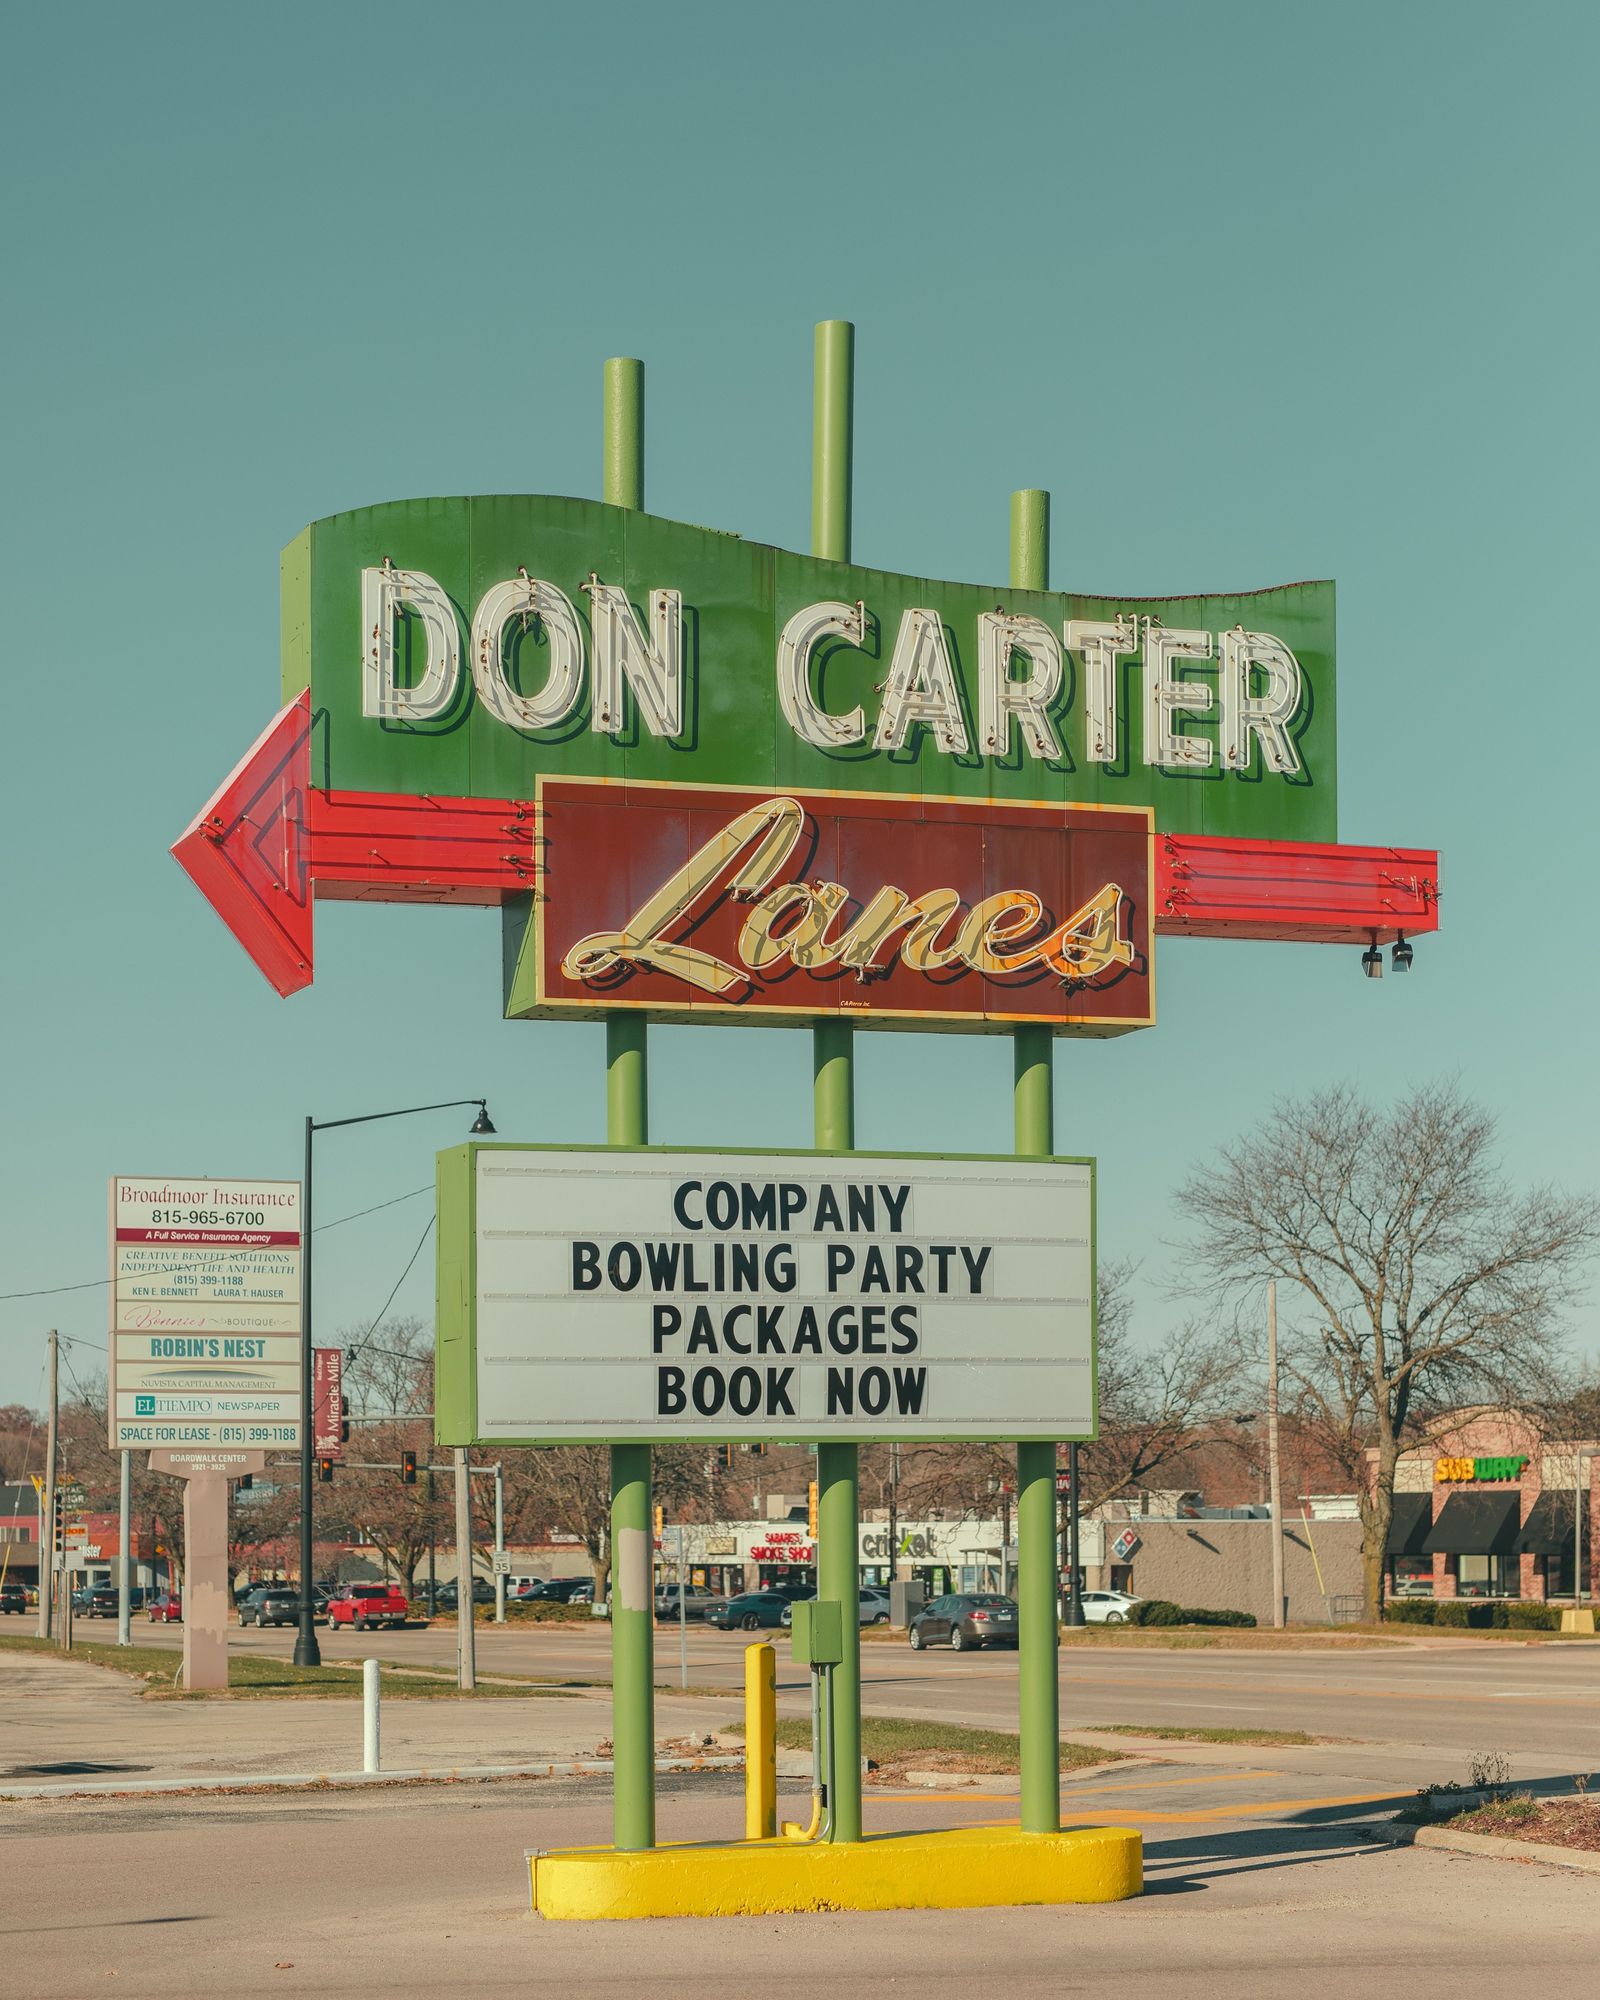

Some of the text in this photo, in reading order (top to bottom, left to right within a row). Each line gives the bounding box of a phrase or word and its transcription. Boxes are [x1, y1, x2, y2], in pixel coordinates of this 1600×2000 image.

[361, 567, 1301, 773] DON CARTER
[560, 795, 1135, 993] Lanes
[120, 1184, 295, 1206] Broadmoor Insurance
[673, 1180, 911, 1233] COMPANY
[152, 1210, 264, 1225] 815-965-6700
[145, 1231, 271, 1243] A Full Service Insurance Agency
[126, 1251, 290, 1262] CREATIVE BENEFIT SOLUTIONS
[121, 1263, 295, 1275] INDEPENDENT LIFE AND HEALTH
[572, 1241, 992, 1294] BOWLING PARTY
[173, 1275, 244, 1286] (815) 399-1188
[132, 1287, 150, 1296] KEN
[161, 1287, 199, 1296] BENNETT
[213, 1288, 240, 1297] LAURA
[251, 1289, 284, 1298] HAUSER
[227, 1318, 273, 1327] BOUTIQUE
[652, 1304, 919, 1355] PACKAGES
[151, 1338, 266, 1358] ROBIN'S NEST
[141, 1380, 276, 1389] NUVISTA CAPITAL MANAGEMENT
[657, 1366, 927, 1417] BOOK NOW
[326, 1354, 339, 1431] Miracle Mile
[137, 1400, 280, 1412] EL TIEMPO NEWSPAPER
[120, 1427, 153, 1440] SPACE
[155, 1428, 176, 1440] FOR
[178, 1428, 210, 1441] LEASE
[219, 1428, 246, 1443] (815)
[249, 1428, 296, 1441] 399-1188
[170, 1454, 247, 1463] BOARDWALK CENTER
[1435, 1454, 1530, 1481] SUBWAY
[751, 1546, 783, 1560] SMOKE
[495, 1563, 508, 1571] 35
